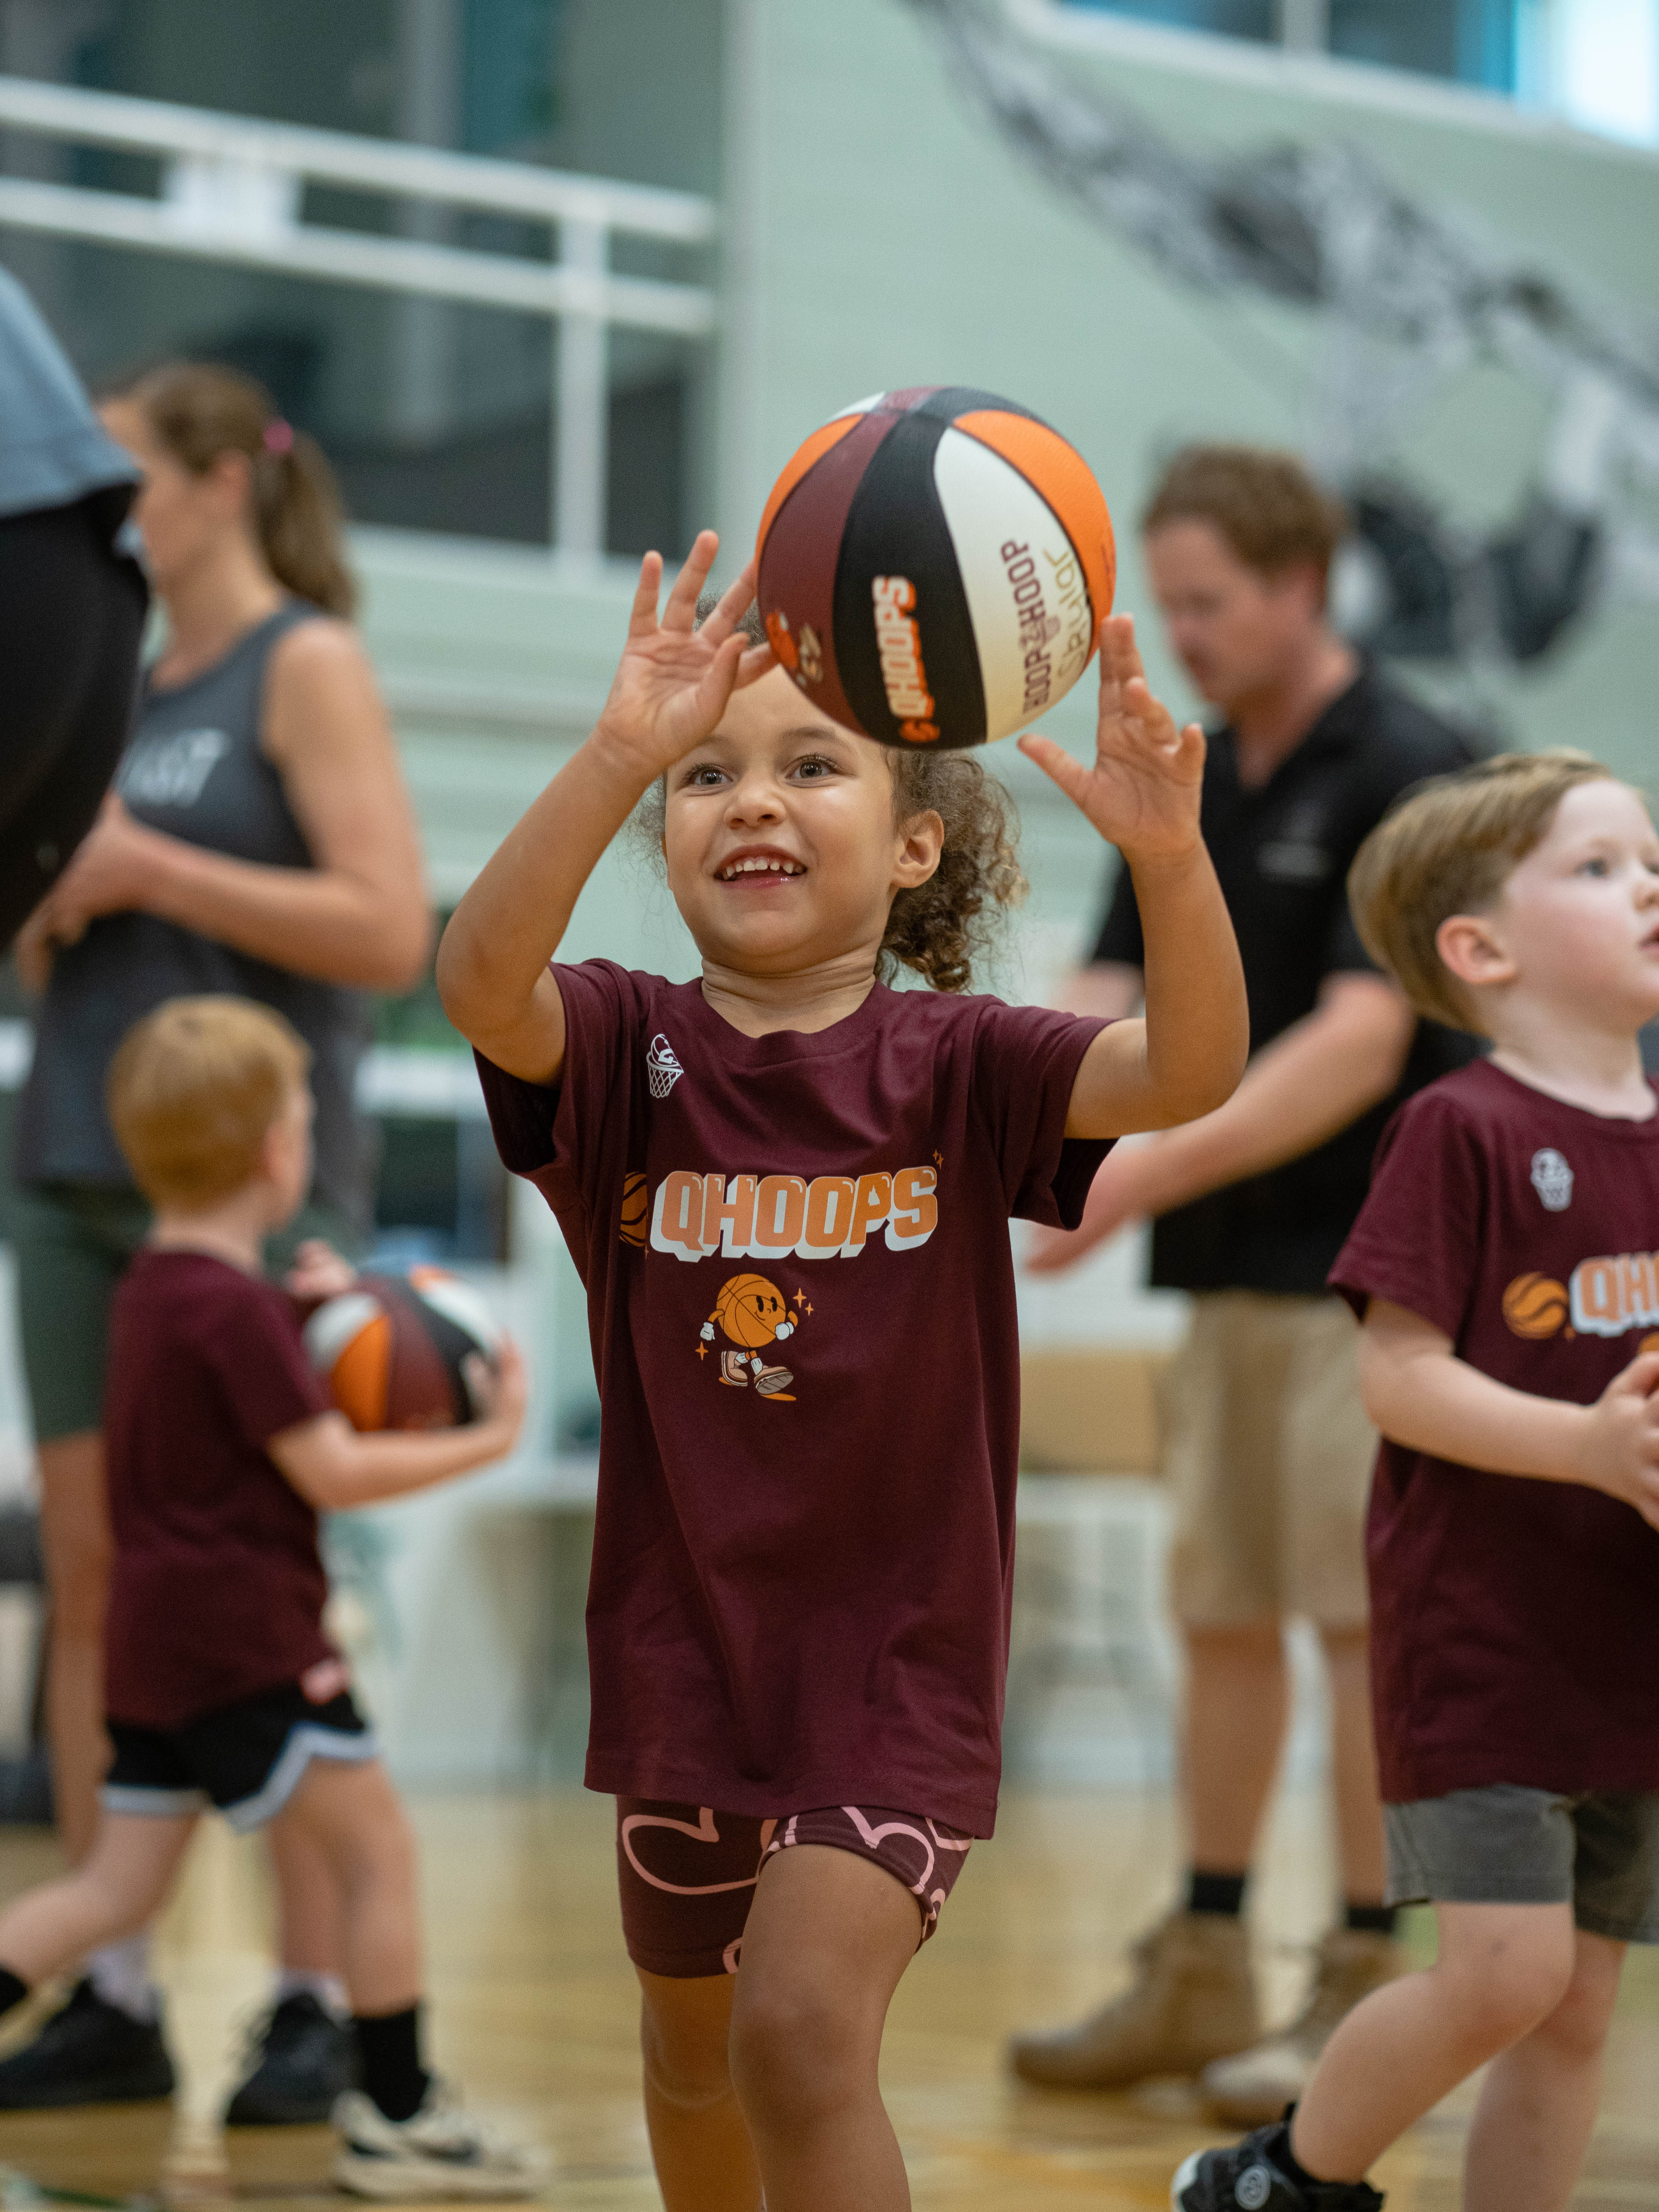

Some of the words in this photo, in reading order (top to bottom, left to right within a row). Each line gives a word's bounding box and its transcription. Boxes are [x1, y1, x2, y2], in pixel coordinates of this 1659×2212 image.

[872, 575, 935, 719] QHOOPS
[650, 1166, 938, 1263] QHOOPS
[1569, 1251, 1659, 1337] QH
